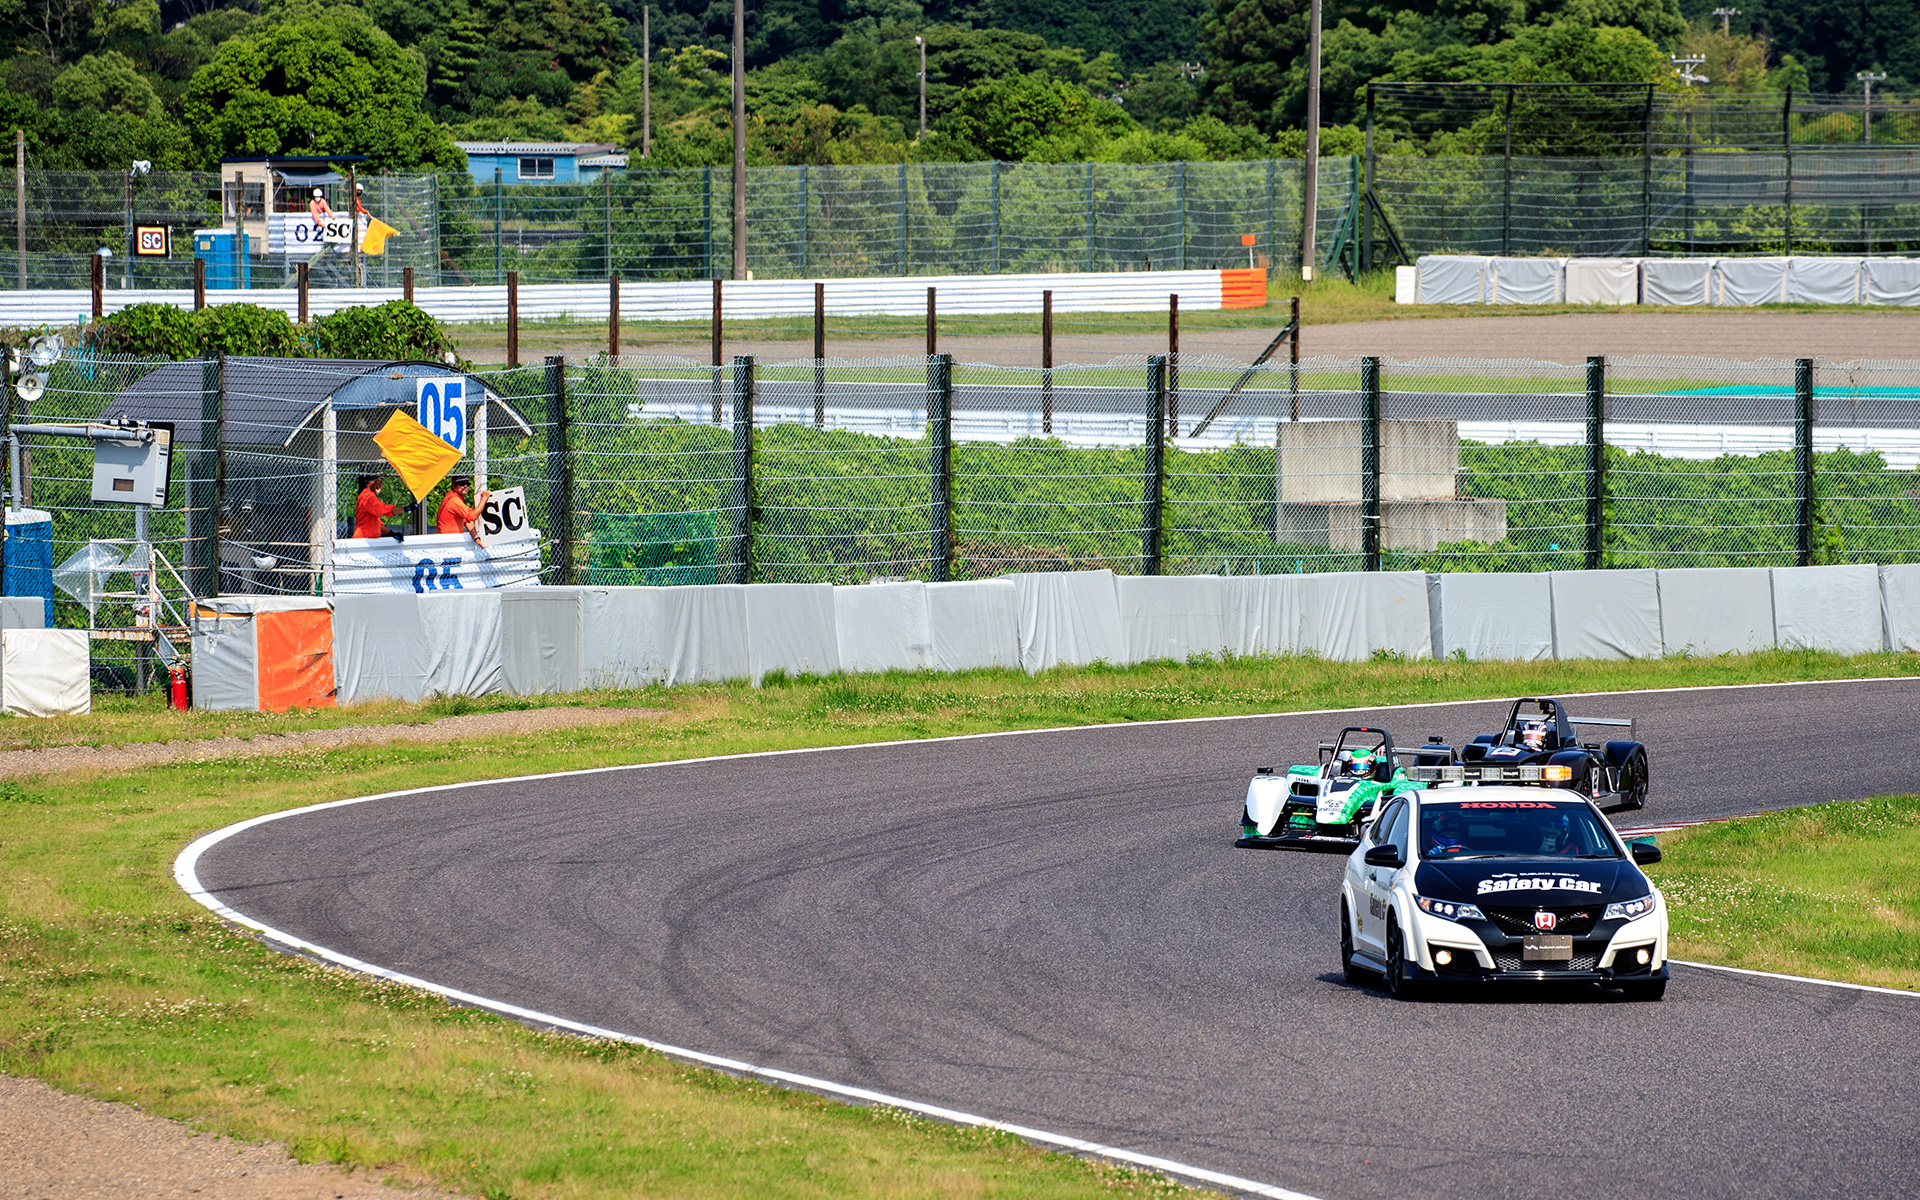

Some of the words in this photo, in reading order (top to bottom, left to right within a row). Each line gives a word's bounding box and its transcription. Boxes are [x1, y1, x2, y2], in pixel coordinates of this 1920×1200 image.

[295, 223, 325, 242] 02
[326, 222, 351, 239] SC
[142, 232, 162, 249] SC
[420, 382, 464, 450] 05
[481, 496, 524, 536] SC
[1477, 877, 1556, 894] Safety
[1559, 877, 1603, 894] Car
